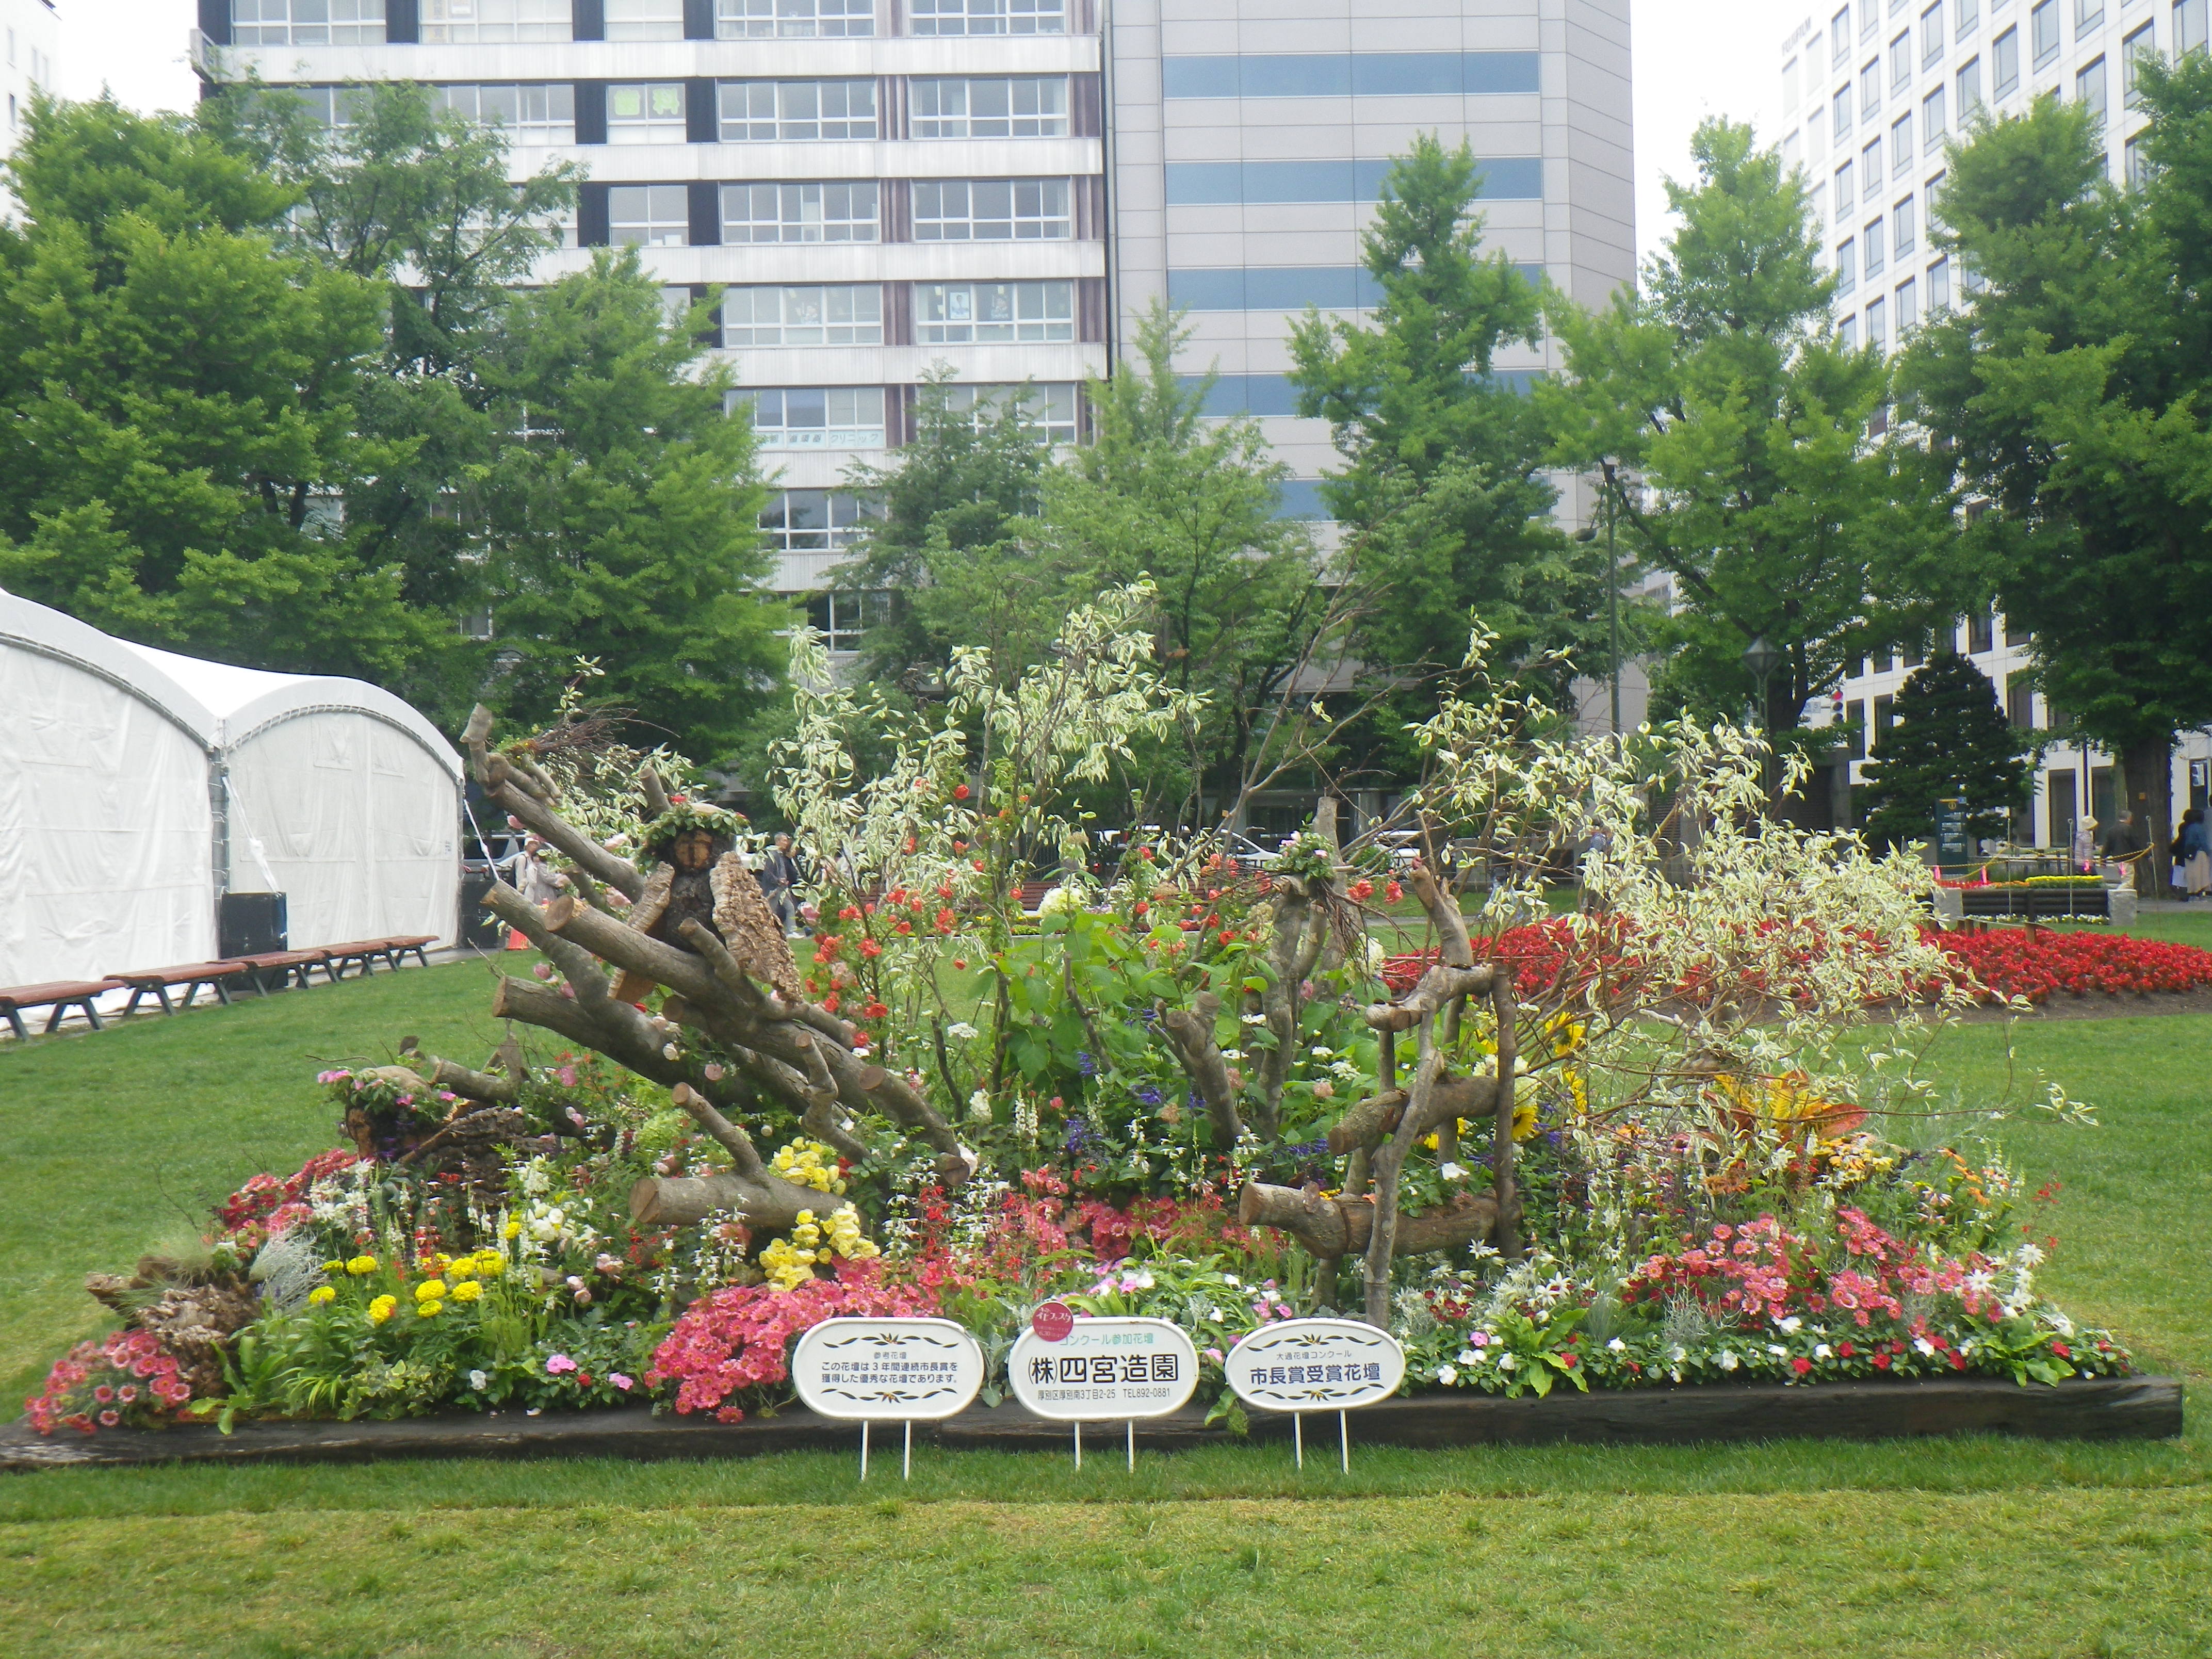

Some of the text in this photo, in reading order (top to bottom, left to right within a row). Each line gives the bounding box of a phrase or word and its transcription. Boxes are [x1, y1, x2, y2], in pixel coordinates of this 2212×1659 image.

[1059, 1333, 1153, 1345] コンクール参加花壇
[822, 1374, 957, 1383] 獲得した優秀な花壇であります。
[1250, 1362, 1380, 1385] 市長賞受賞花壇
